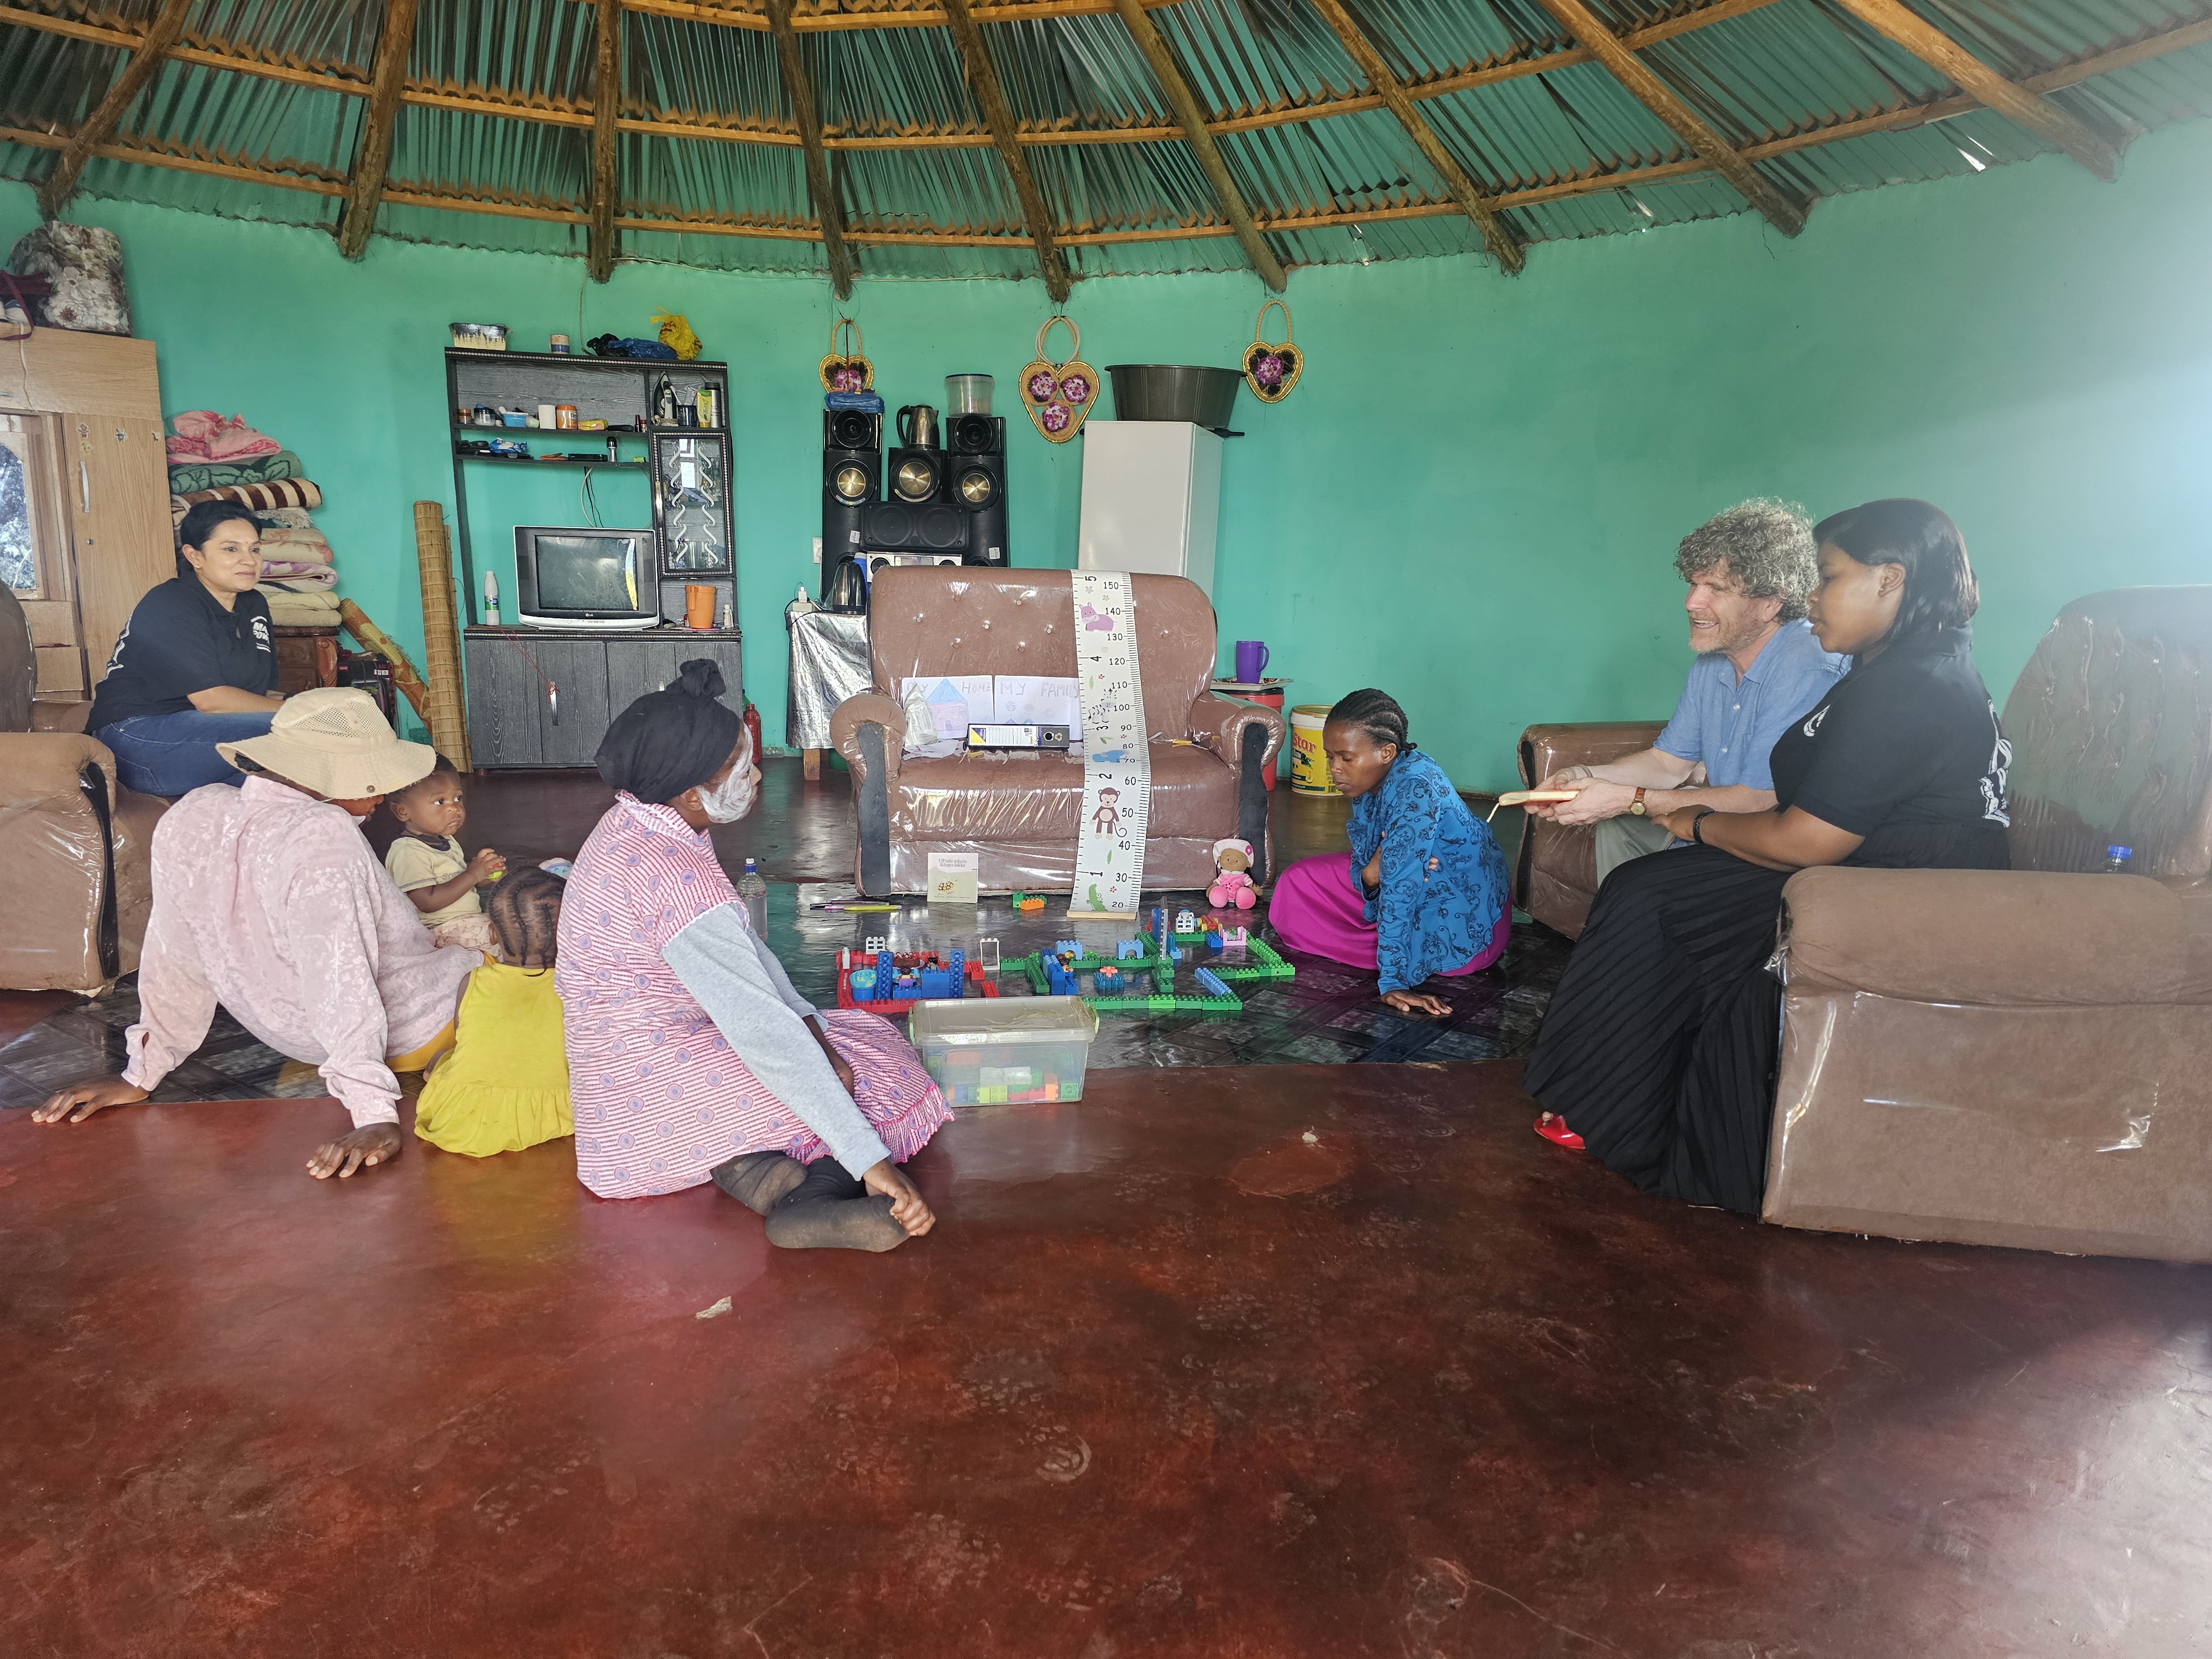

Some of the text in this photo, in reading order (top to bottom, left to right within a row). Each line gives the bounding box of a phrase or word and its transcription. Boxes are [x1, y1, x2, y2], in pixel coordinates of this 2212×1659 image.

[1000, 681, 1079, 698] MY FAMILY
[1125, 777, 1136, 785] 60
[1122, 808, 1134, 817] 50
[1119, 841, 1130, 850] 40
[1115, 873, 1127, 883] 30
